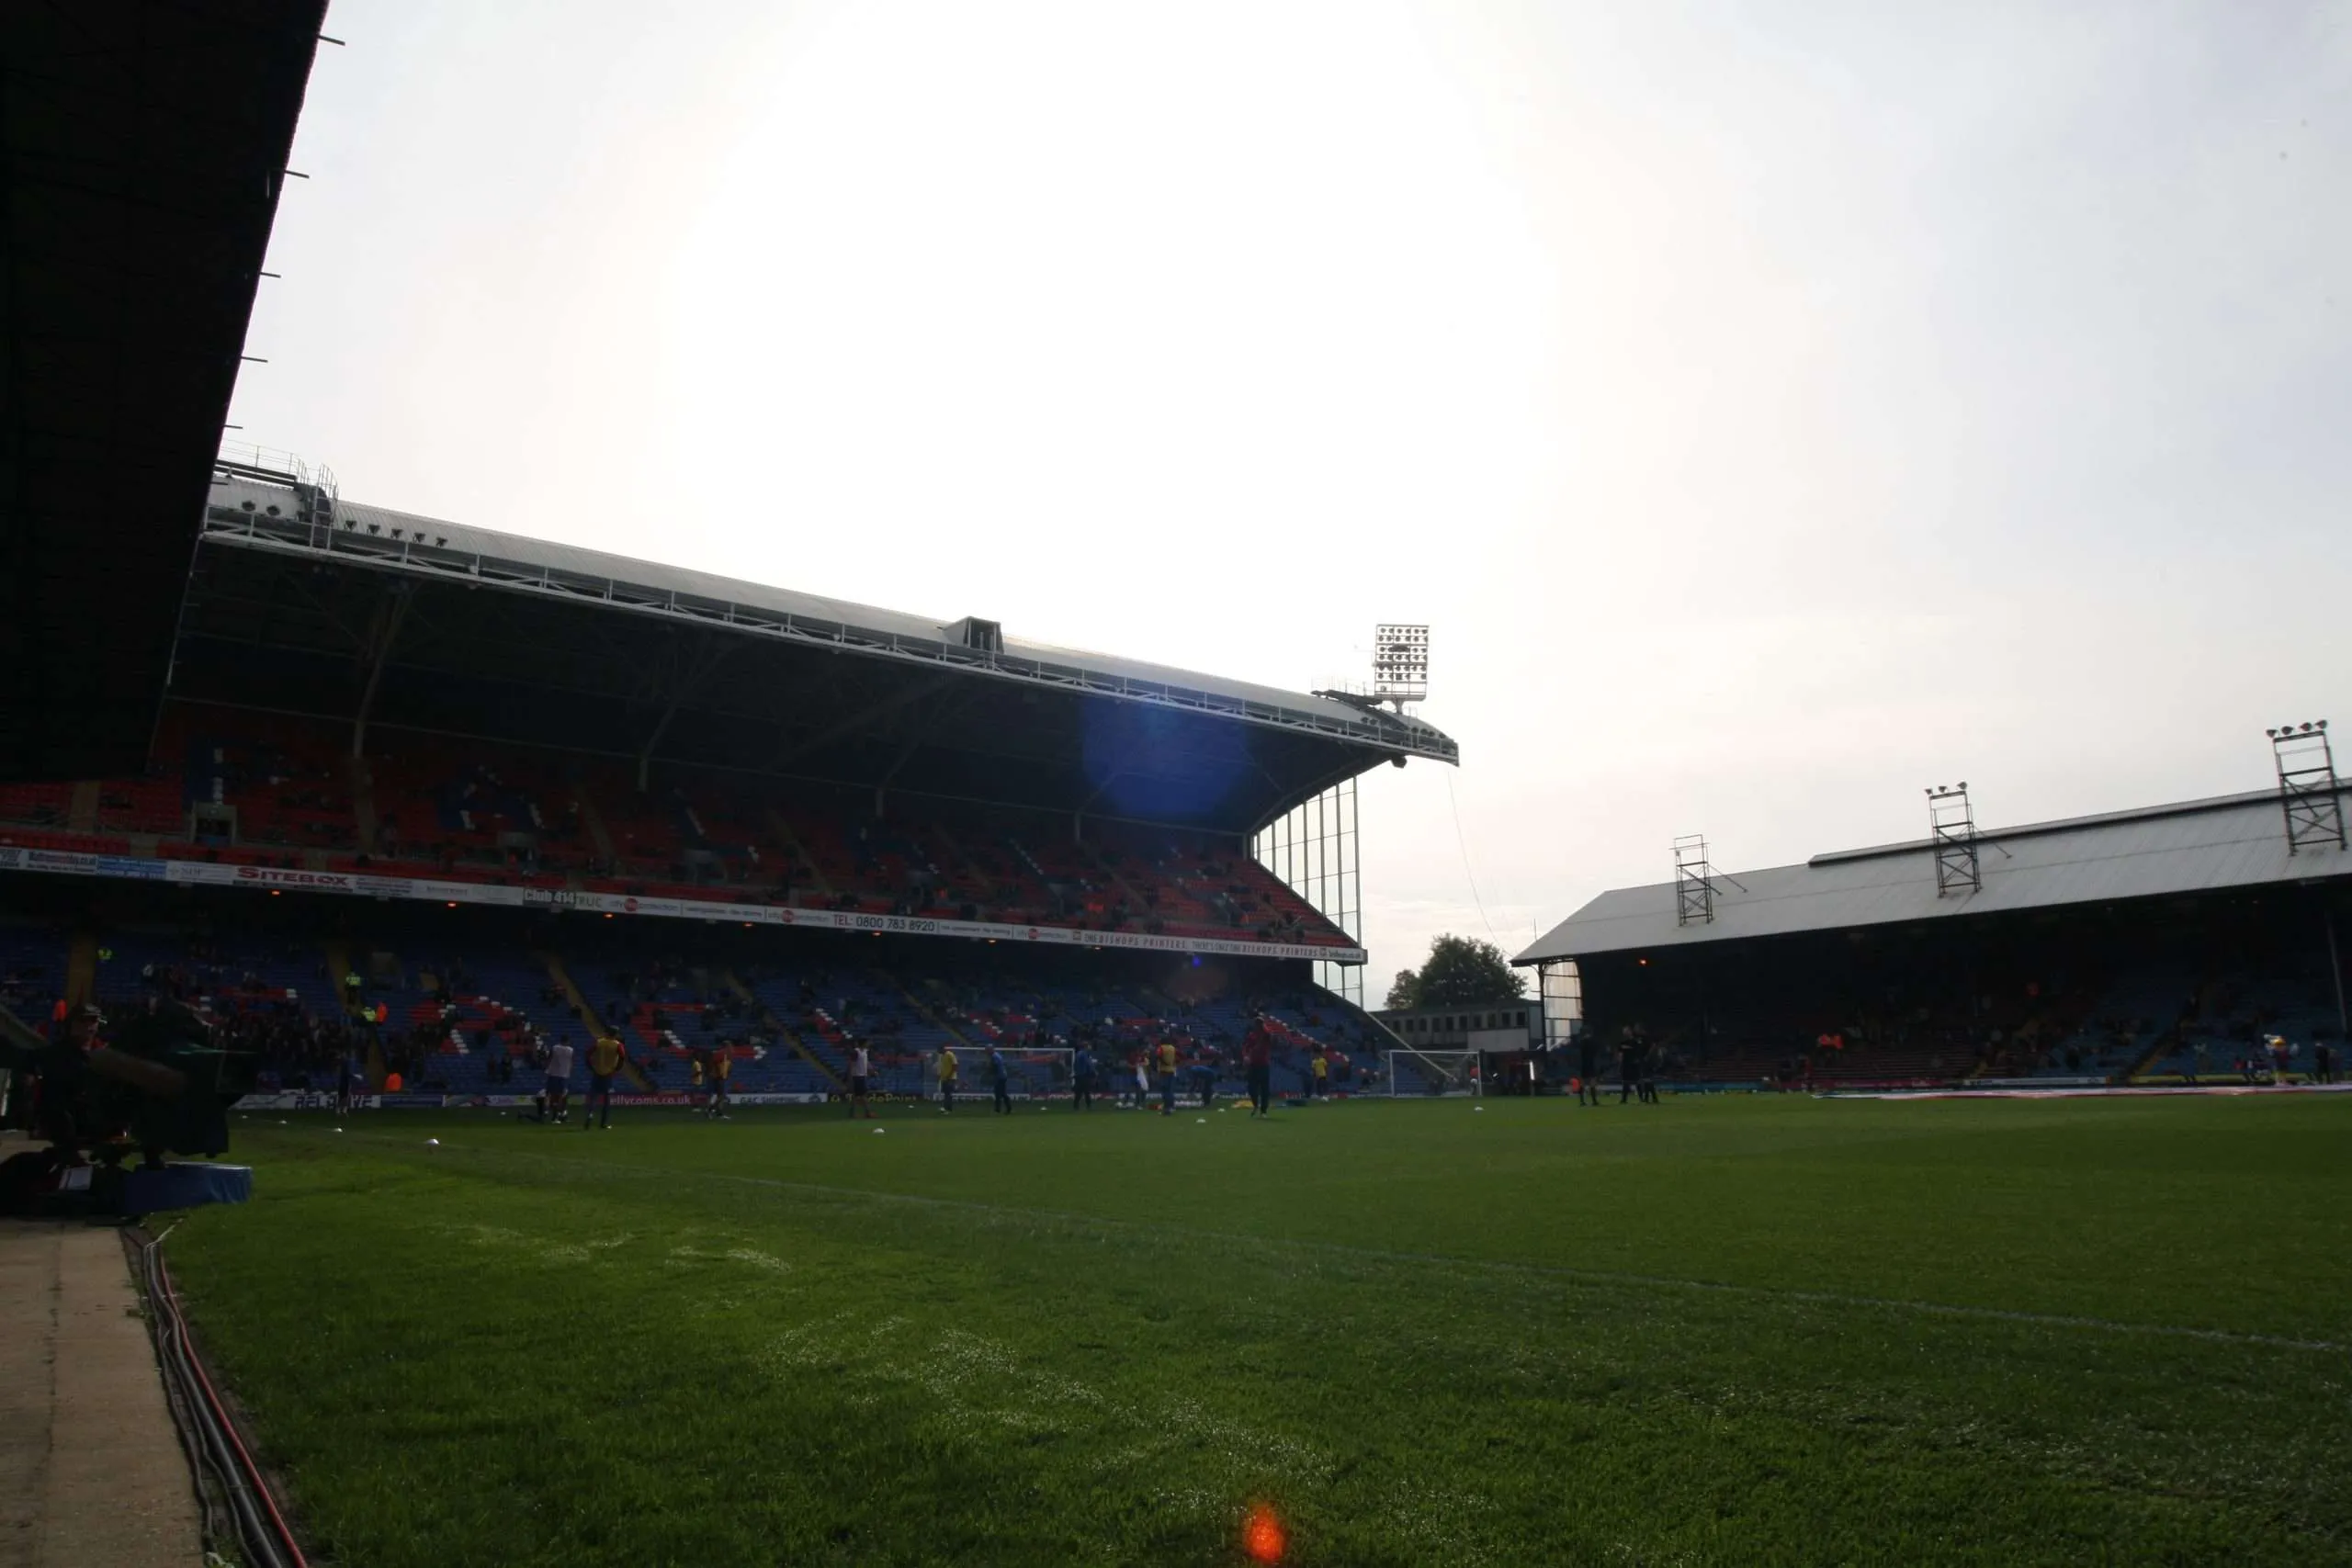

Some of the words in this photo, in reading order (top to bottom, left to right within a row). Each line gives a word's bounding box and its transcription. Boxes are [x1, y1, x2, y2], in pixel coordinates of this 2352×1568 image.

[237, 867, 347, 886] SITEBOX
[525, 888, 552, 902] Club
[855, 916, 883, 929] 0800
[887, 918, 905, 930] 783
[909, 919, 935, 931] 8920
